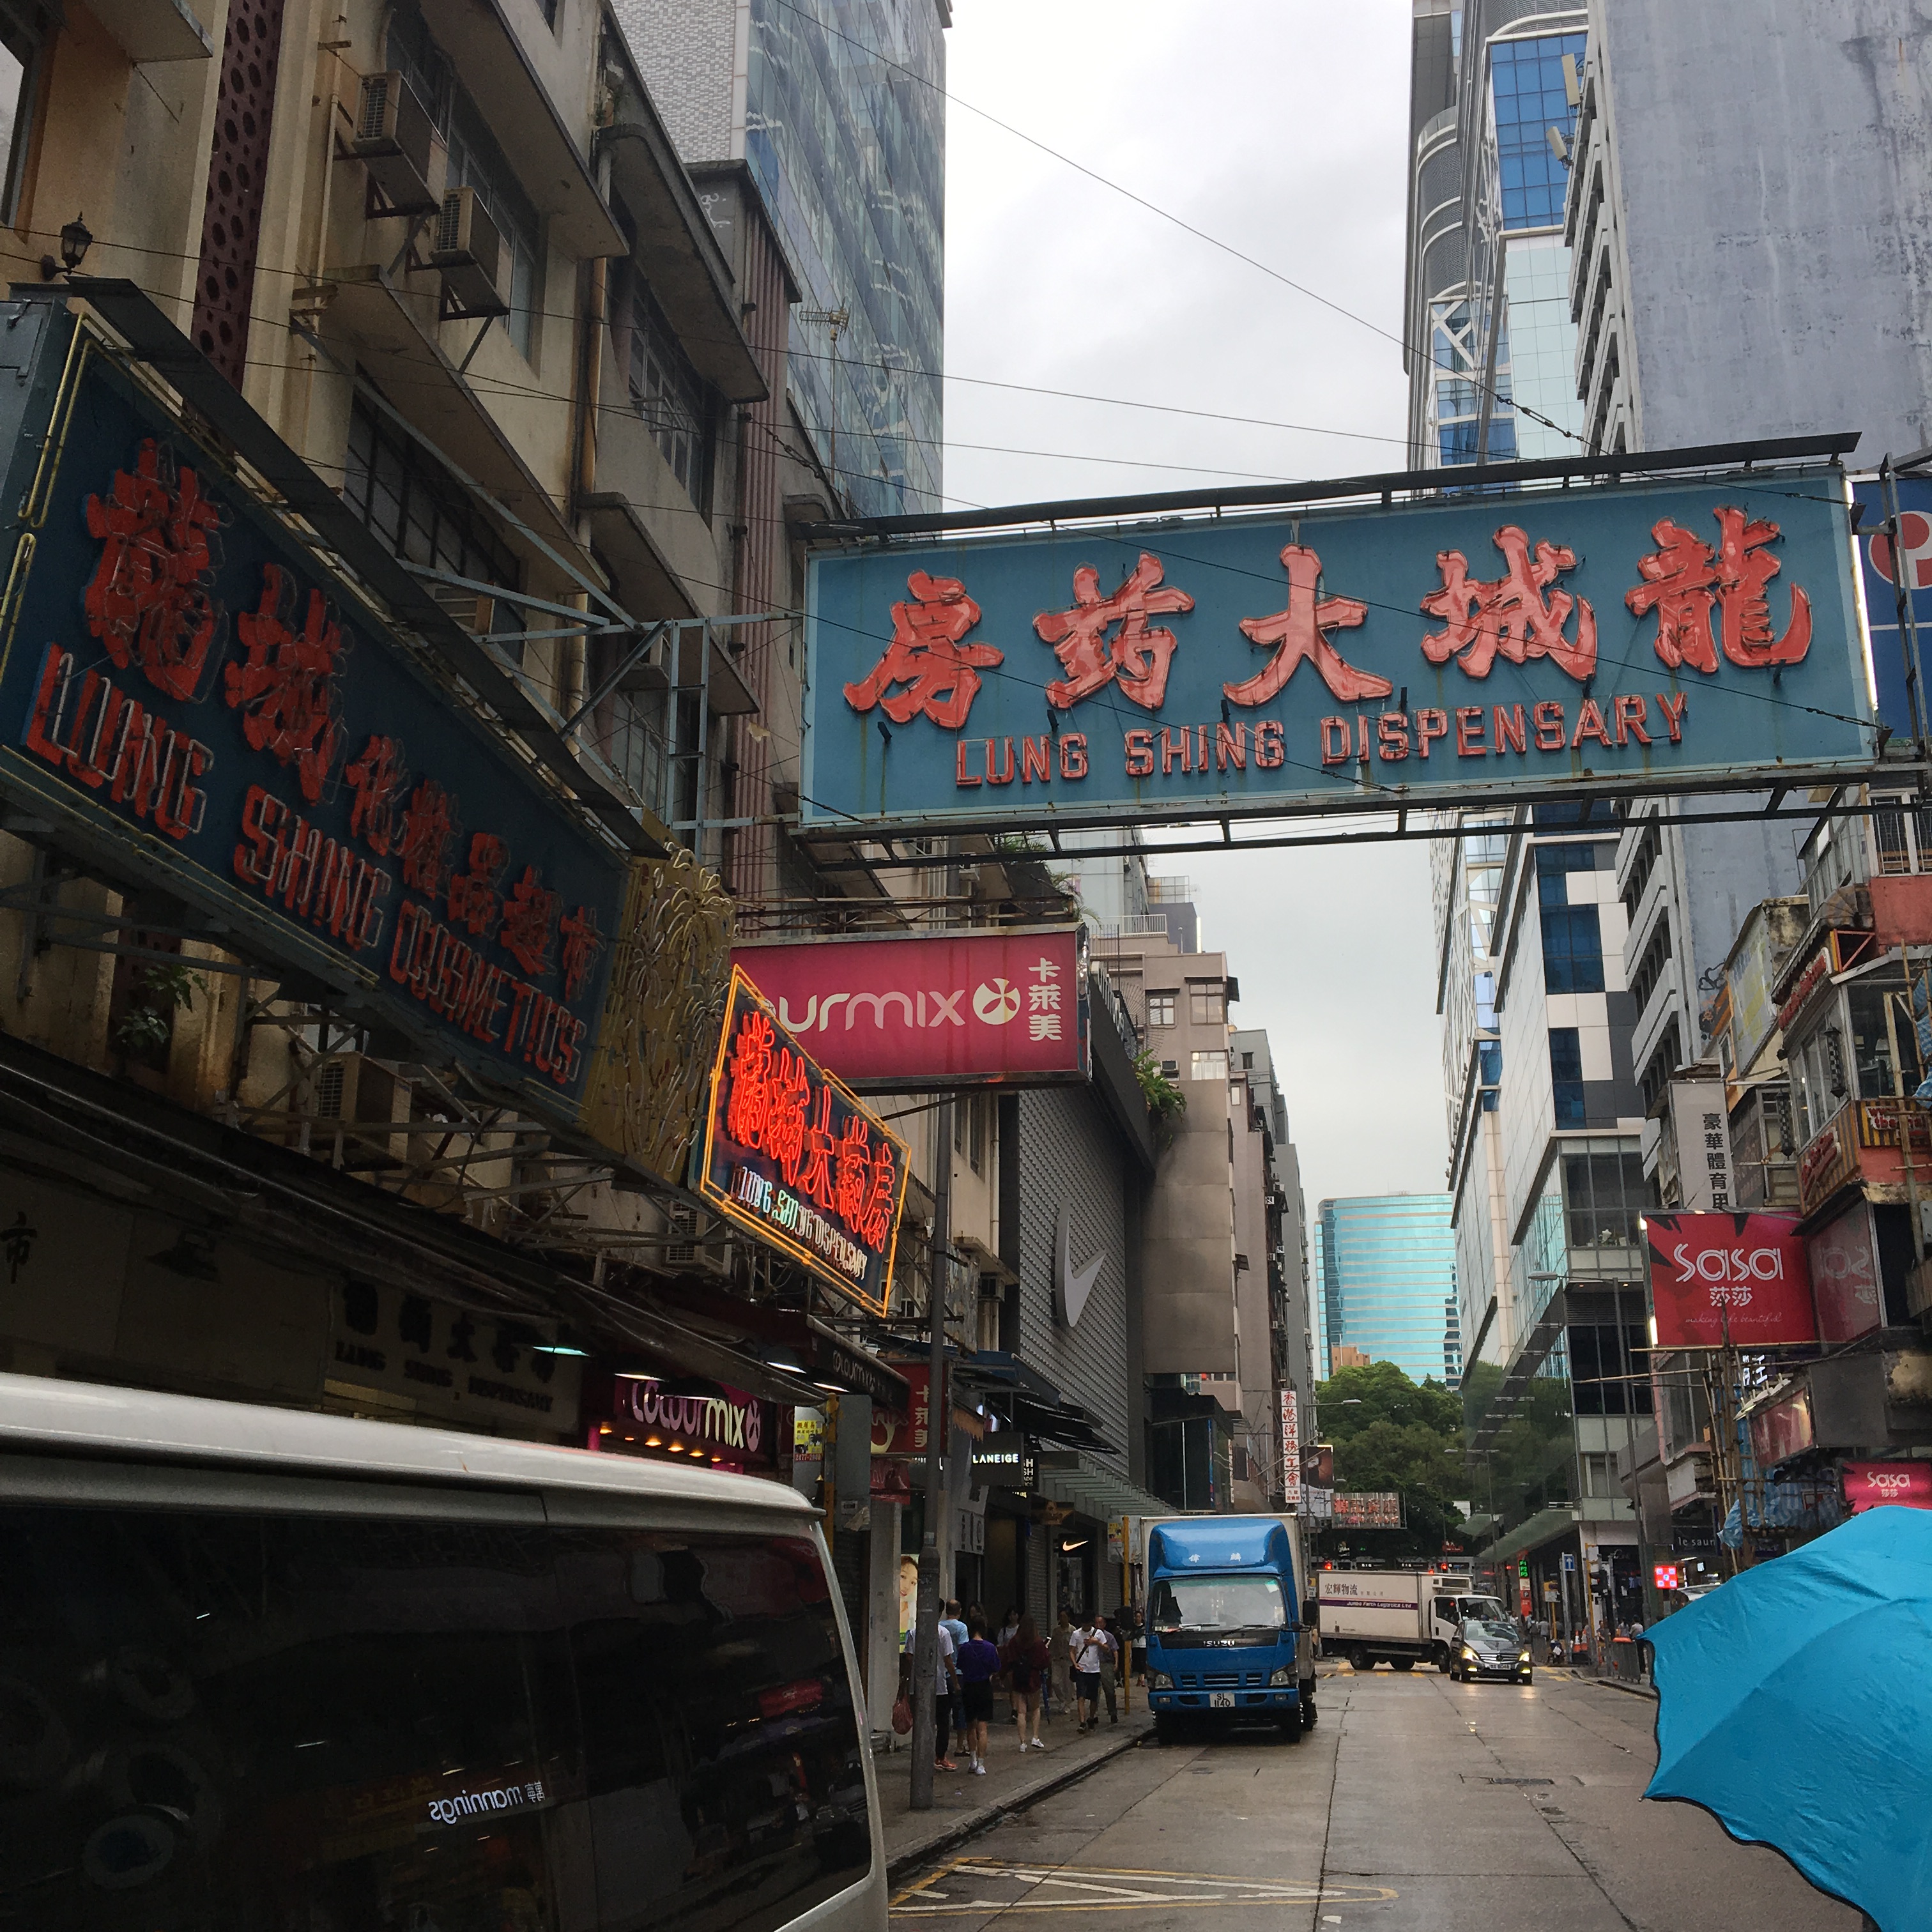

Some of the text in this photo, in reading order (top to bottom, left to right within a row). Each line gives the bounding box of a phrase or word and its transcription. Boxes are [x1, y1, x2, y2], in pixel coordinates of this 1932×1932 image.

[956, 693, 1688, 788] LUNG SHING DISPENSARY
[24, 641, 588, 1085] LUNG SHING COSMETICS
[1028, 957, 1064, 1042] 卡萊美
[734, 1164, 773, 1214] LUNG
[1673, 1243, 1784, 1282] Sasa
[1709, 1286, 1753, 1307] 莎莎
[1685, 1313, 1718, 1328] making
[1740, 1312, 1782, 1328] beautiful
[972, 1453, 1020, 1464] LANEIGE
[1867, 1471, 1911, 1489] Sasa
